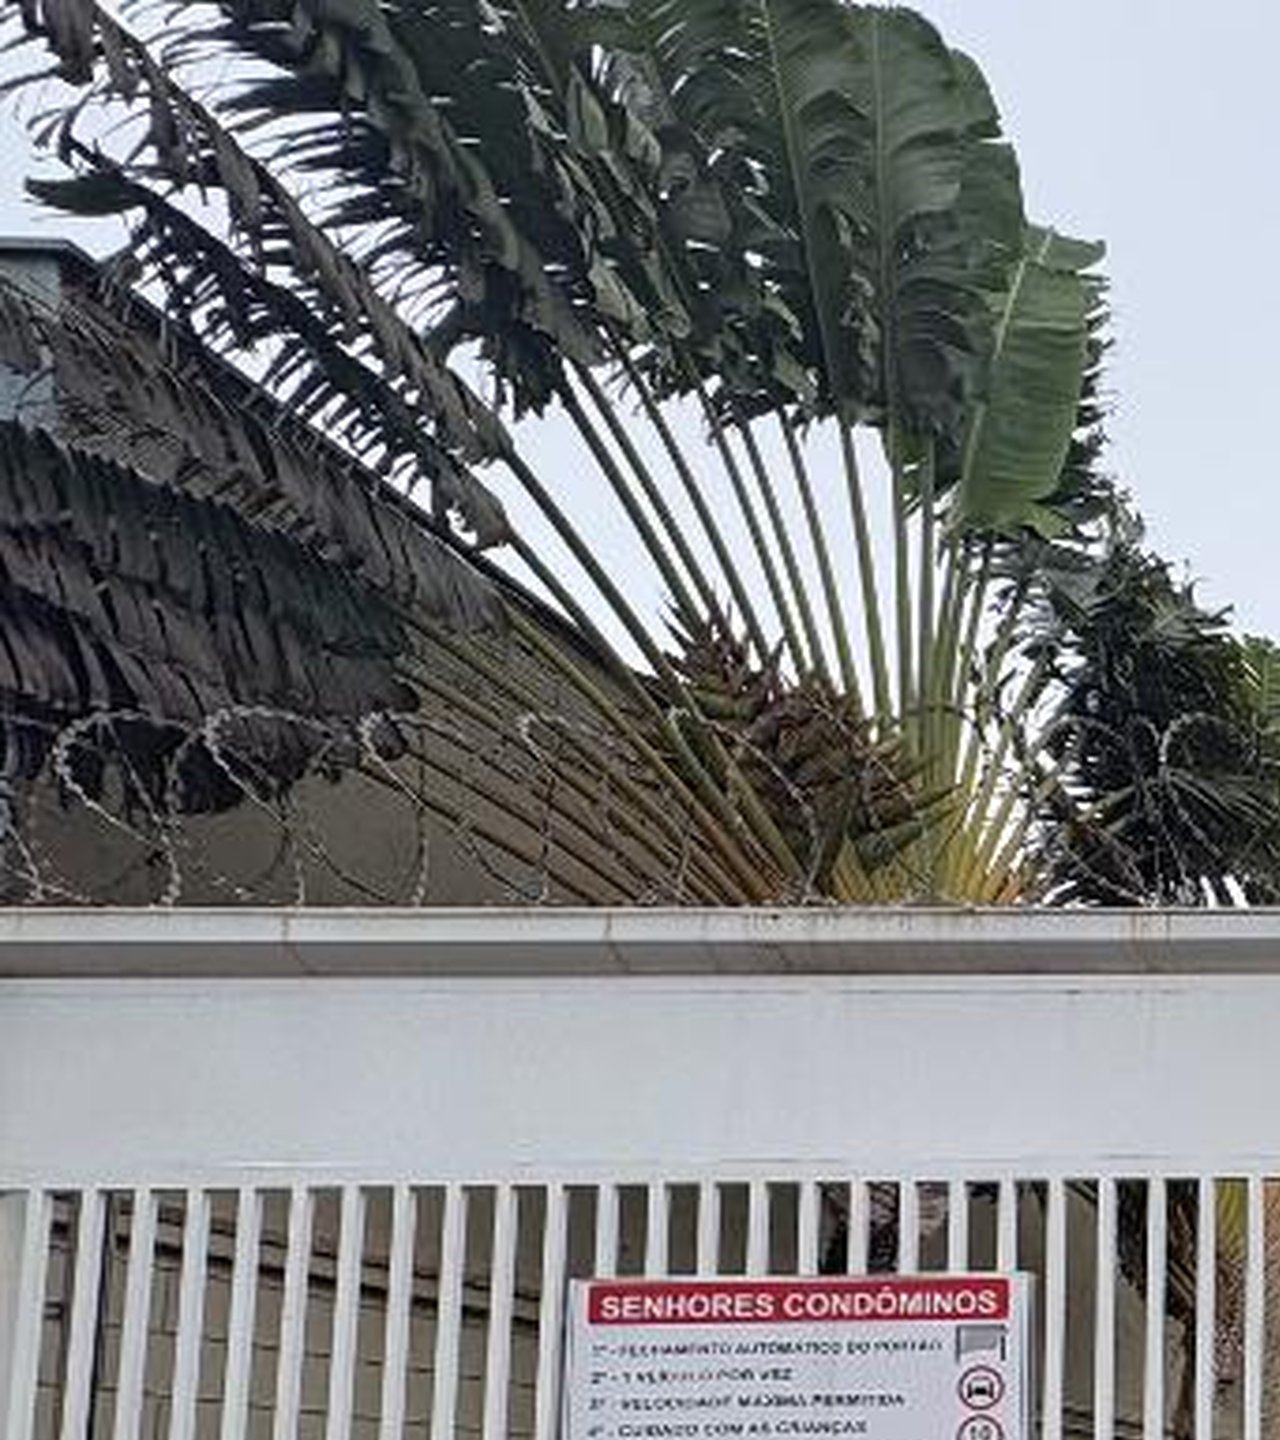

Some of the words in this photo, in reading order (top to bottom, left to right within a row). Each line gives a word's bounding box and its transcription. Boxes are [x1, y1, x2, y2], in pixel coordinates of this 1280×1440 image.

[601, 1293, 774, 1319] SENHORES
[783, 1286, 998, 1316] CONDÔMINOS
[703, 1422, 743, 1437] COM
